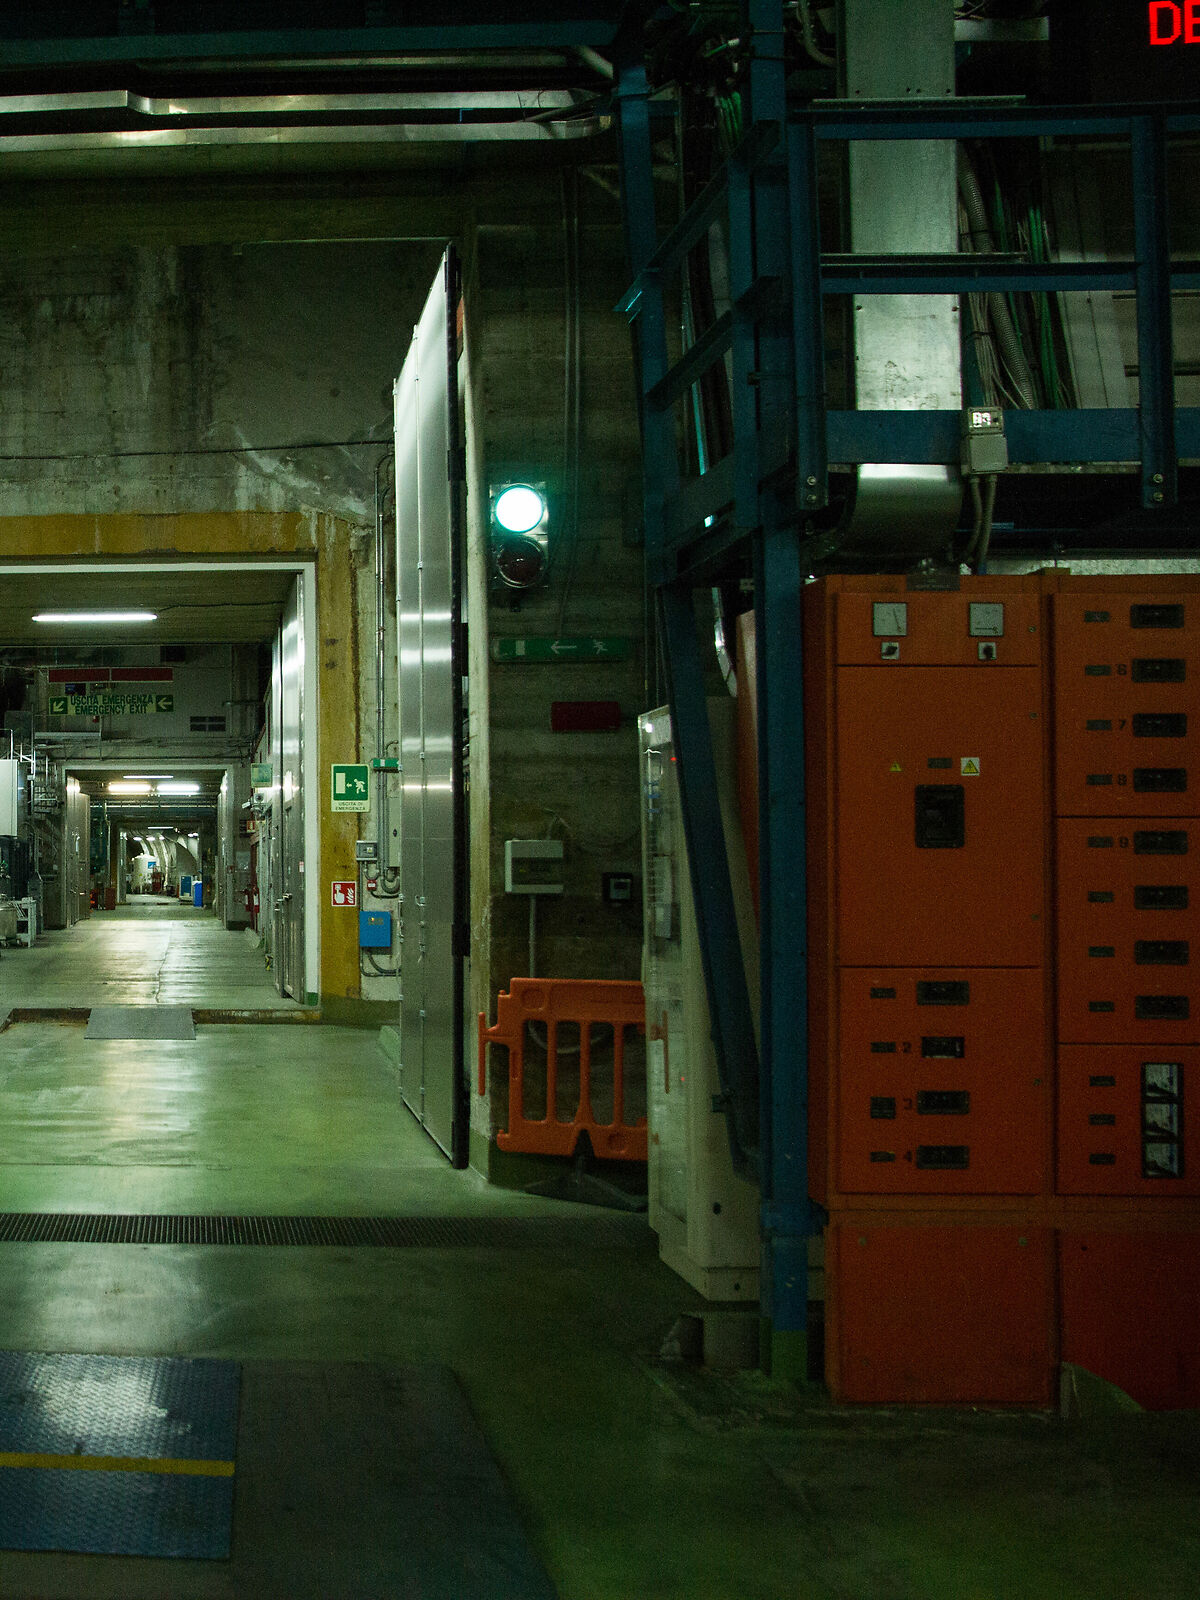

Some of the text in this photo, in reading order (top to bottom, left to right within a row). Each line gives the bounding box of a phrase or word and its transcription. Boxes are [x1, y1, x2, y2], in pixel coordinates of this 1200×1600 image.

[70, 693, 154, 706] USCITA EMERGENZA
[75, 703, 148, 715] EMERGENCY EXIT
